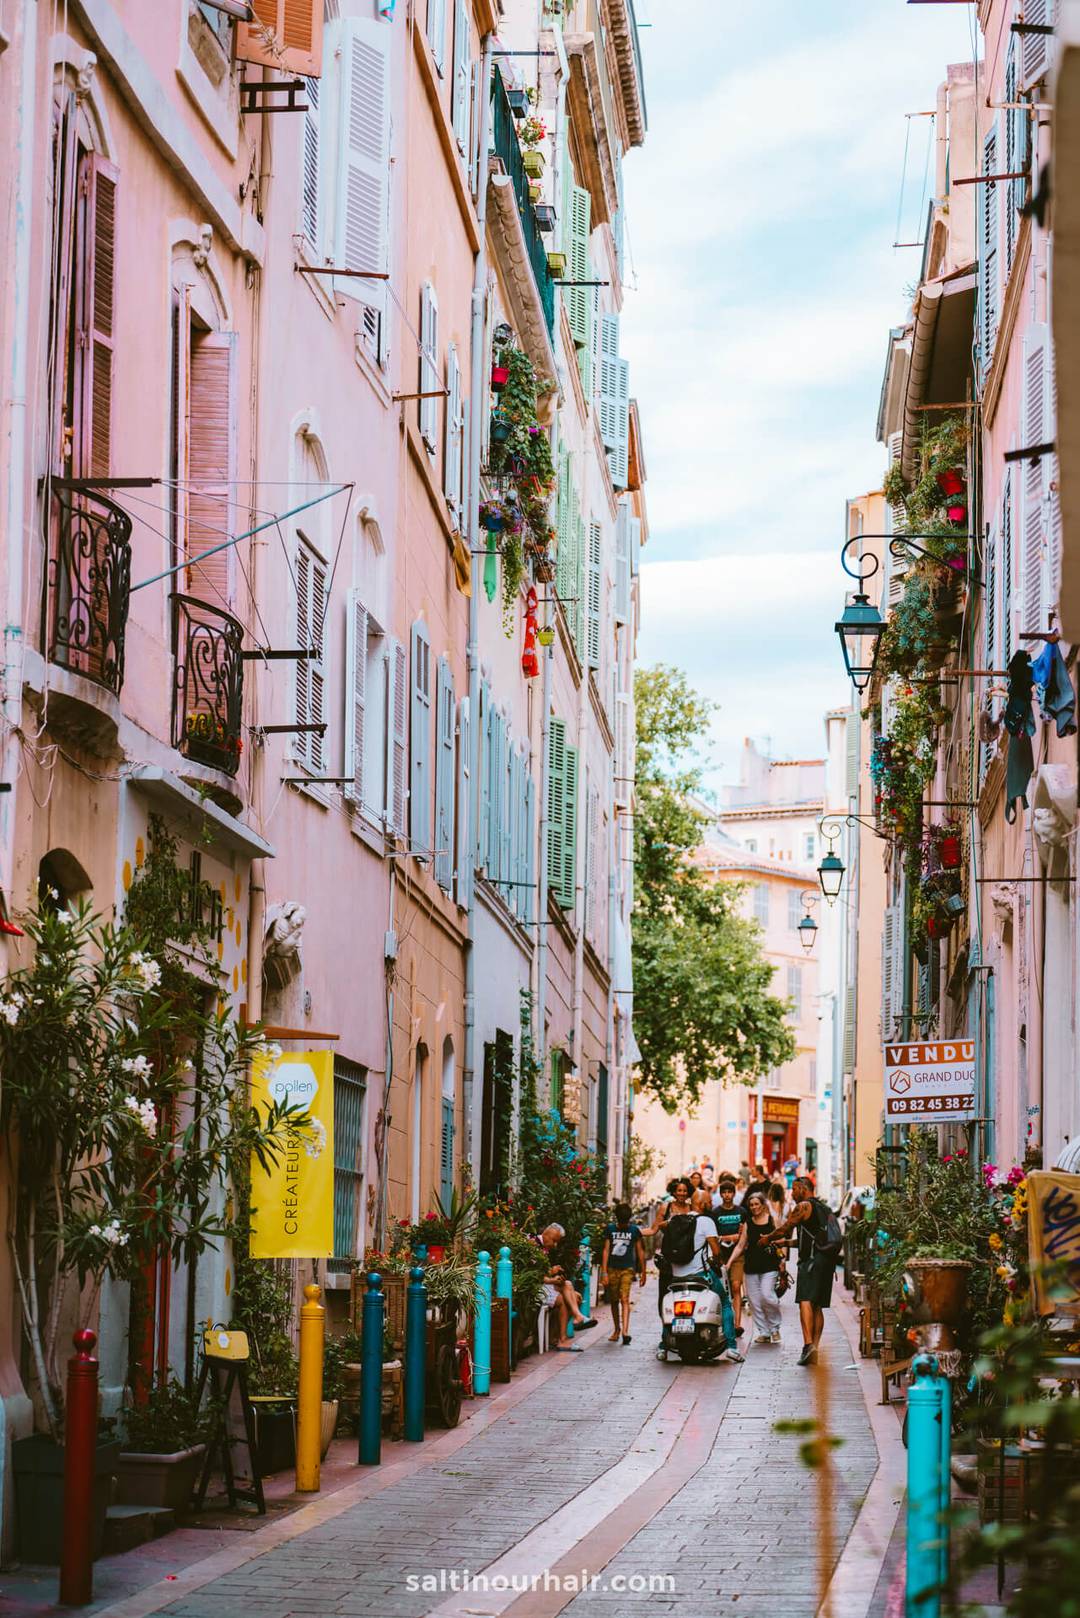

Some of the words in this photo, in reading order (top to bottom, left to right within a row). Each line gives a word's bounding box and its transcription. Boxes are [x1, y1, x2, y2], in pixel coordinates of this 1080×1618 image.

[890, 1044, 975, 1064] VENDU
[914, 1072, 952, 1083] GRAND
[274, 1080, 312, 1094] pollen
[892, 1100, 907, 1112] 09
[910, 1099, 925, 1111] 82
[927, 1098, 943, 1110] 45
[945, 1098, 960, 1109] 38
[611, 1231, 632, 1240] TEAM
